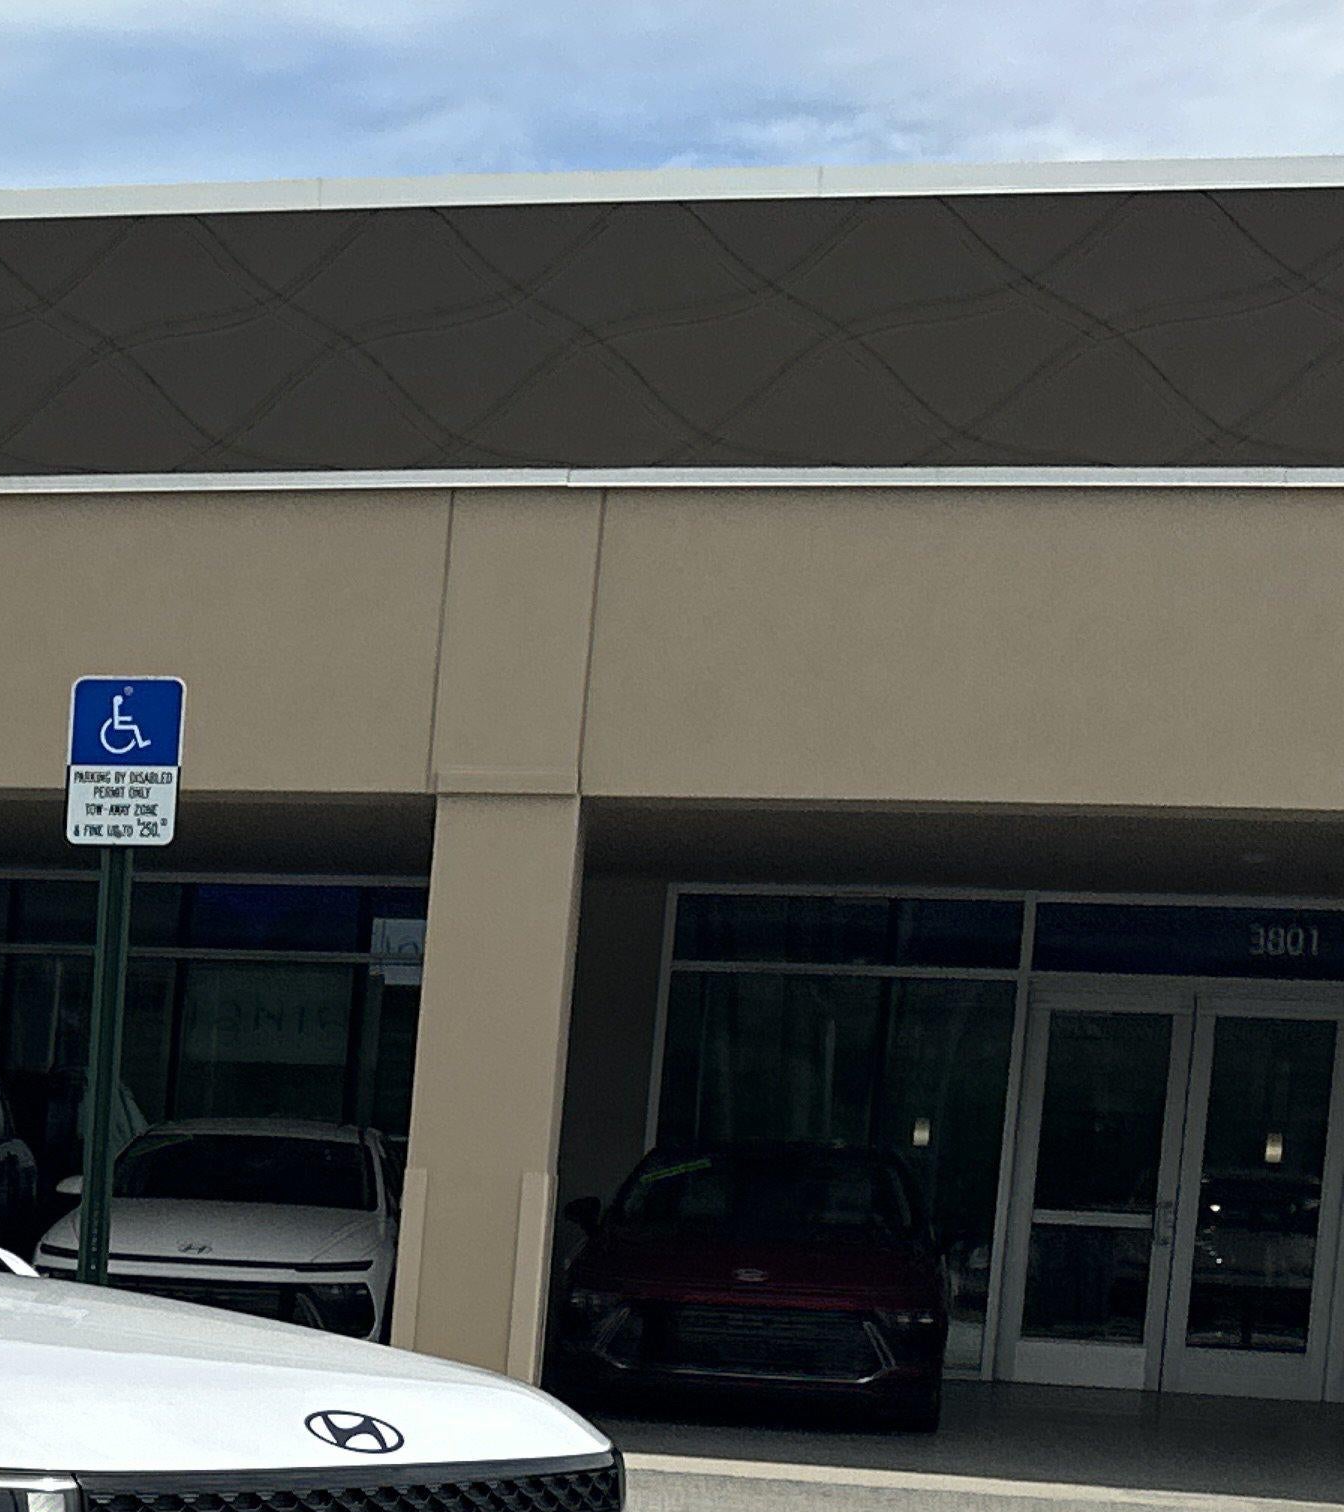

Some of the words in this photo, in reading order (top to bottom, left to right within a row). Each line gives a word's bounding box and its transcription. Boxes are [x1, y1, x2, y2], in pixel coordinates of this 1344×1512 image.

[73, 771, 111, 784] PARKING
[114, 771, 127, 784] BY
[129, 771, 172, 785] DISABLED
[93, 786, 125, 799] PERMIT
[128, 786, 152, 799] ONLY
[133, 803, 159, 817] ZONE
[83, 824, 103, 837] FINE
